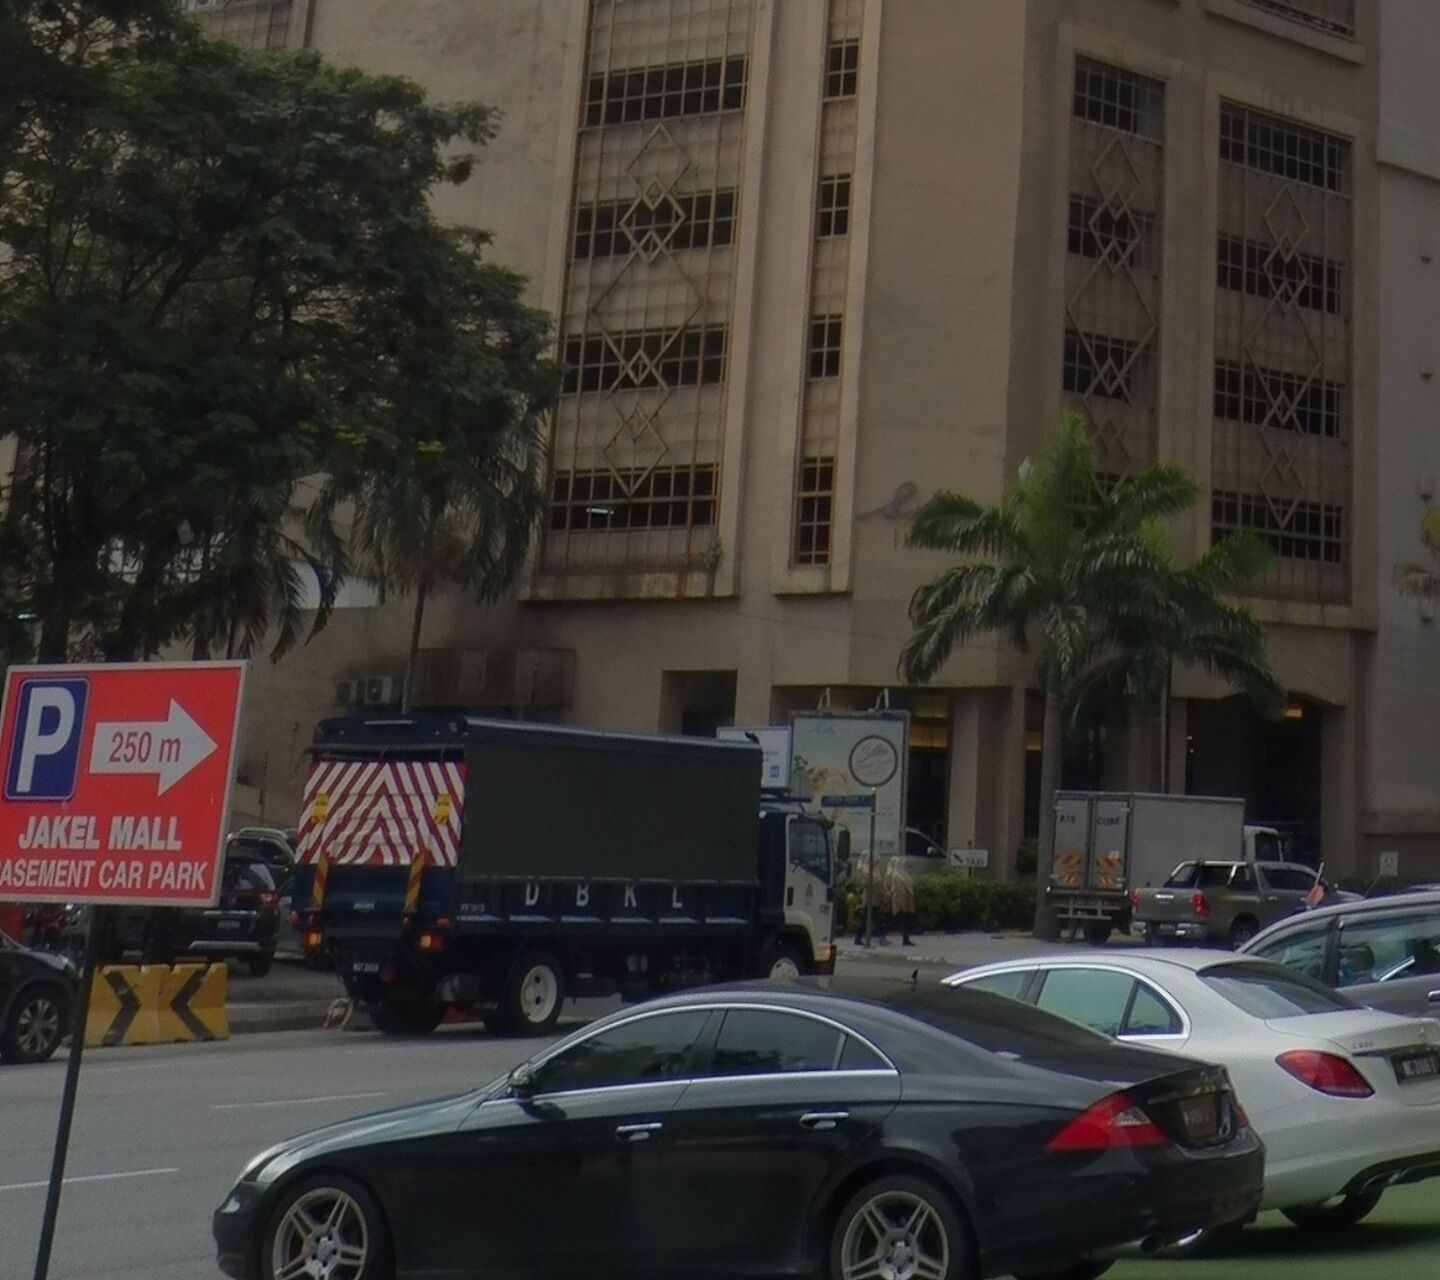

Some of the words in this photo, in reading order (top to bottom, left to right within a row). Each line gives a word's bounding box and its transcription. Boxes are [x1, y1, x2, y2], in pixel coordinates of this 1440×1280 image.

[16, 686, 75, 793] P
[109, 731, 151, 763] 250
[159, 738, 181, 763] m
[18, 815, 100, 850] JAKEL
[108, 815, 182, 851] MALL
[0, 857, 96, 888] ASEMENT
[98, 859, 143, 889] CAR
[147, 861, 206, 891] PARK
